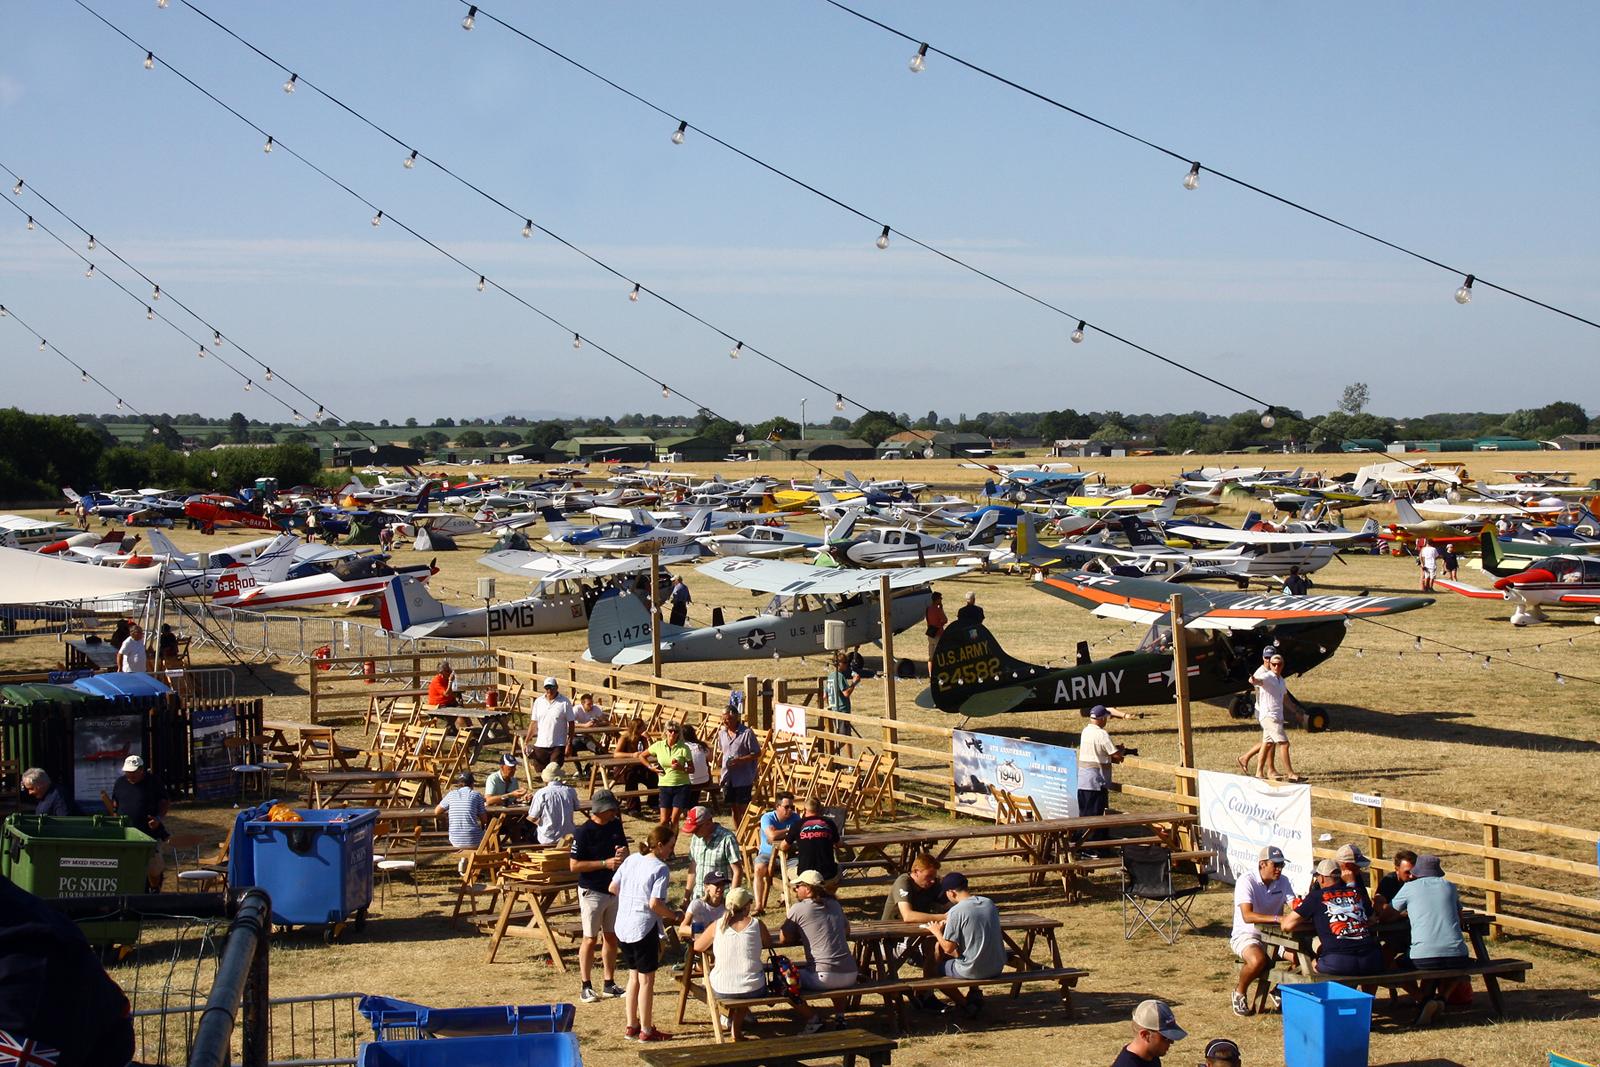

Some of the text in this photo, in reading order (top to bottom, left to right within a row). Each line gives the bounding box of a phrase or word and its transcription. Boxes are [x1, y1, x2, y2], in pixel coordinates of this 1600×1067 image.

[488, 605, 534, 632] BMG
[937, 657, 1001, 692] 24582
[1053, 669, 1125, 704] ARMY
[1000, 770, 1021, 783] 1940
[1228, 795, 1279, 821] Cambrai
[59, 876, 118, 892] PG SKIPS
